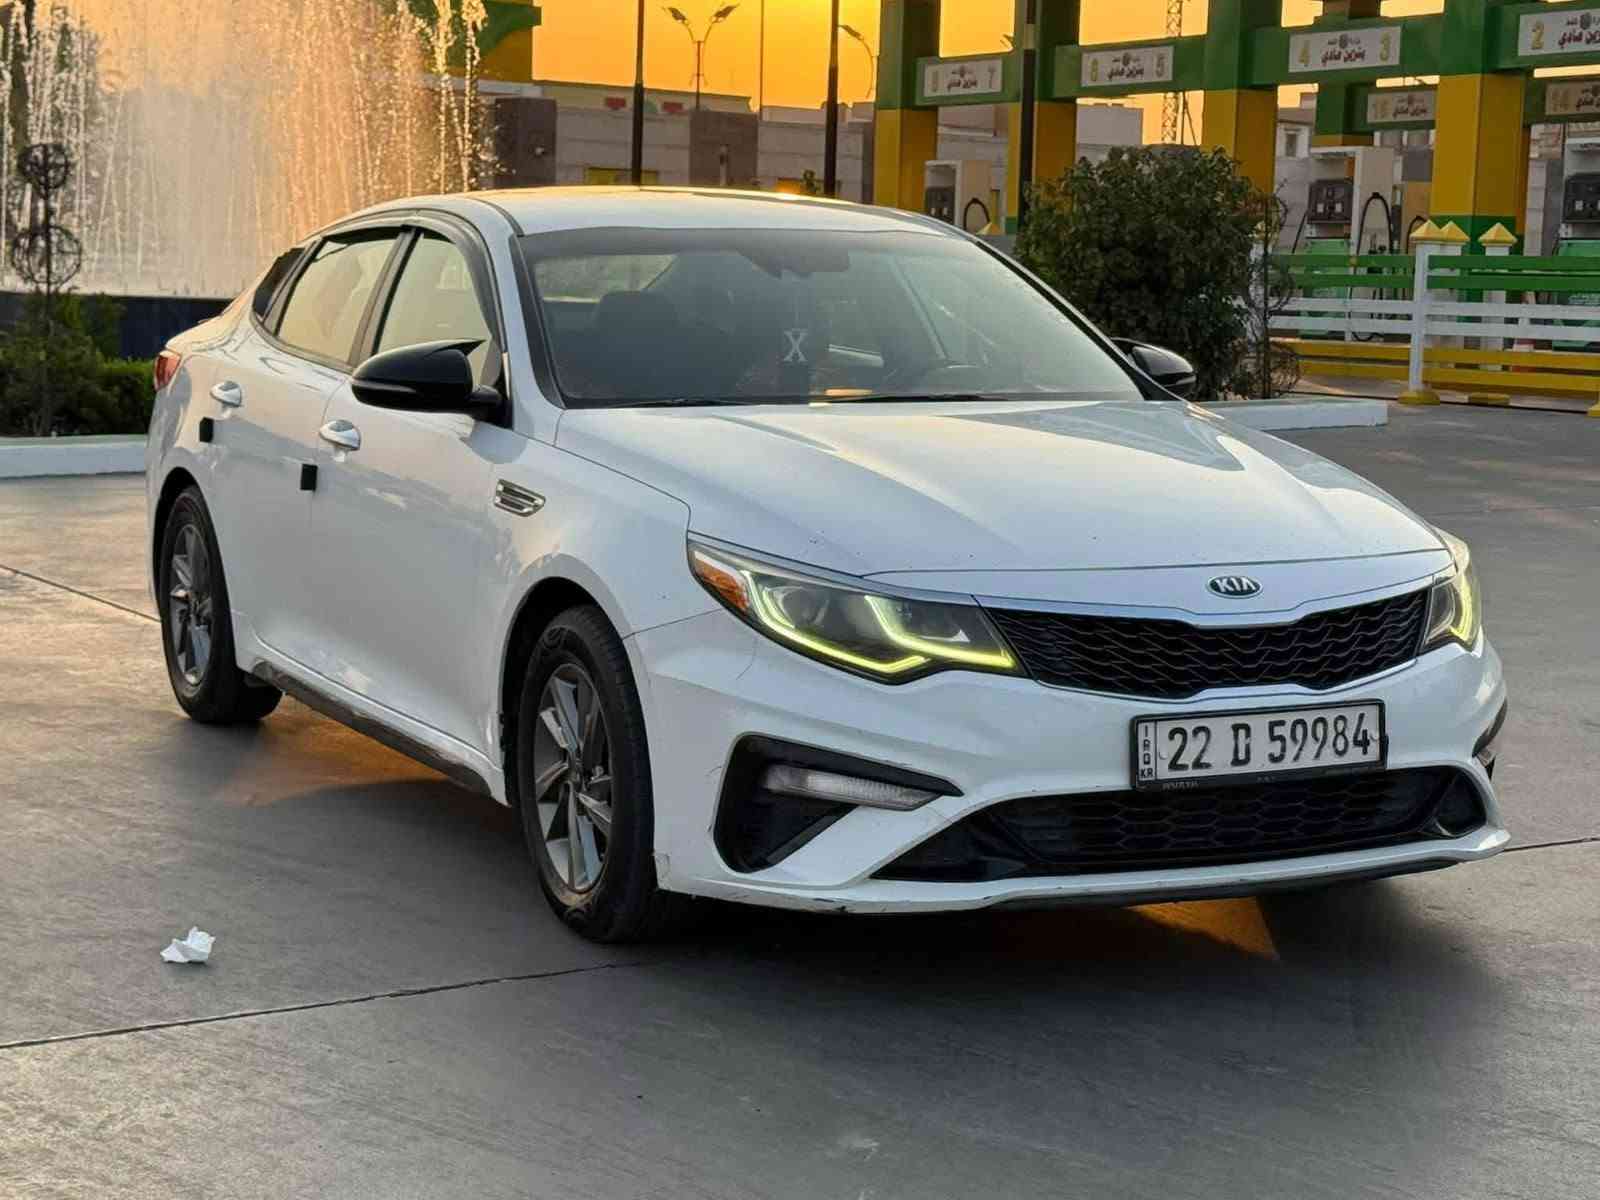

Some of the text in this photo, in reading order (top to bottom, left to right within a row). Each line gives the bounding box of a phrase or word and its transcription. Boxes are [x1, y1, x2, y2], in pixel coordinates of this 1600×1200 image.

[1532, 22, 1544, 50] 2
[1215, 576, 1256, 592] KIA
[1168, 713, 1370, 771] 22 D 59984
